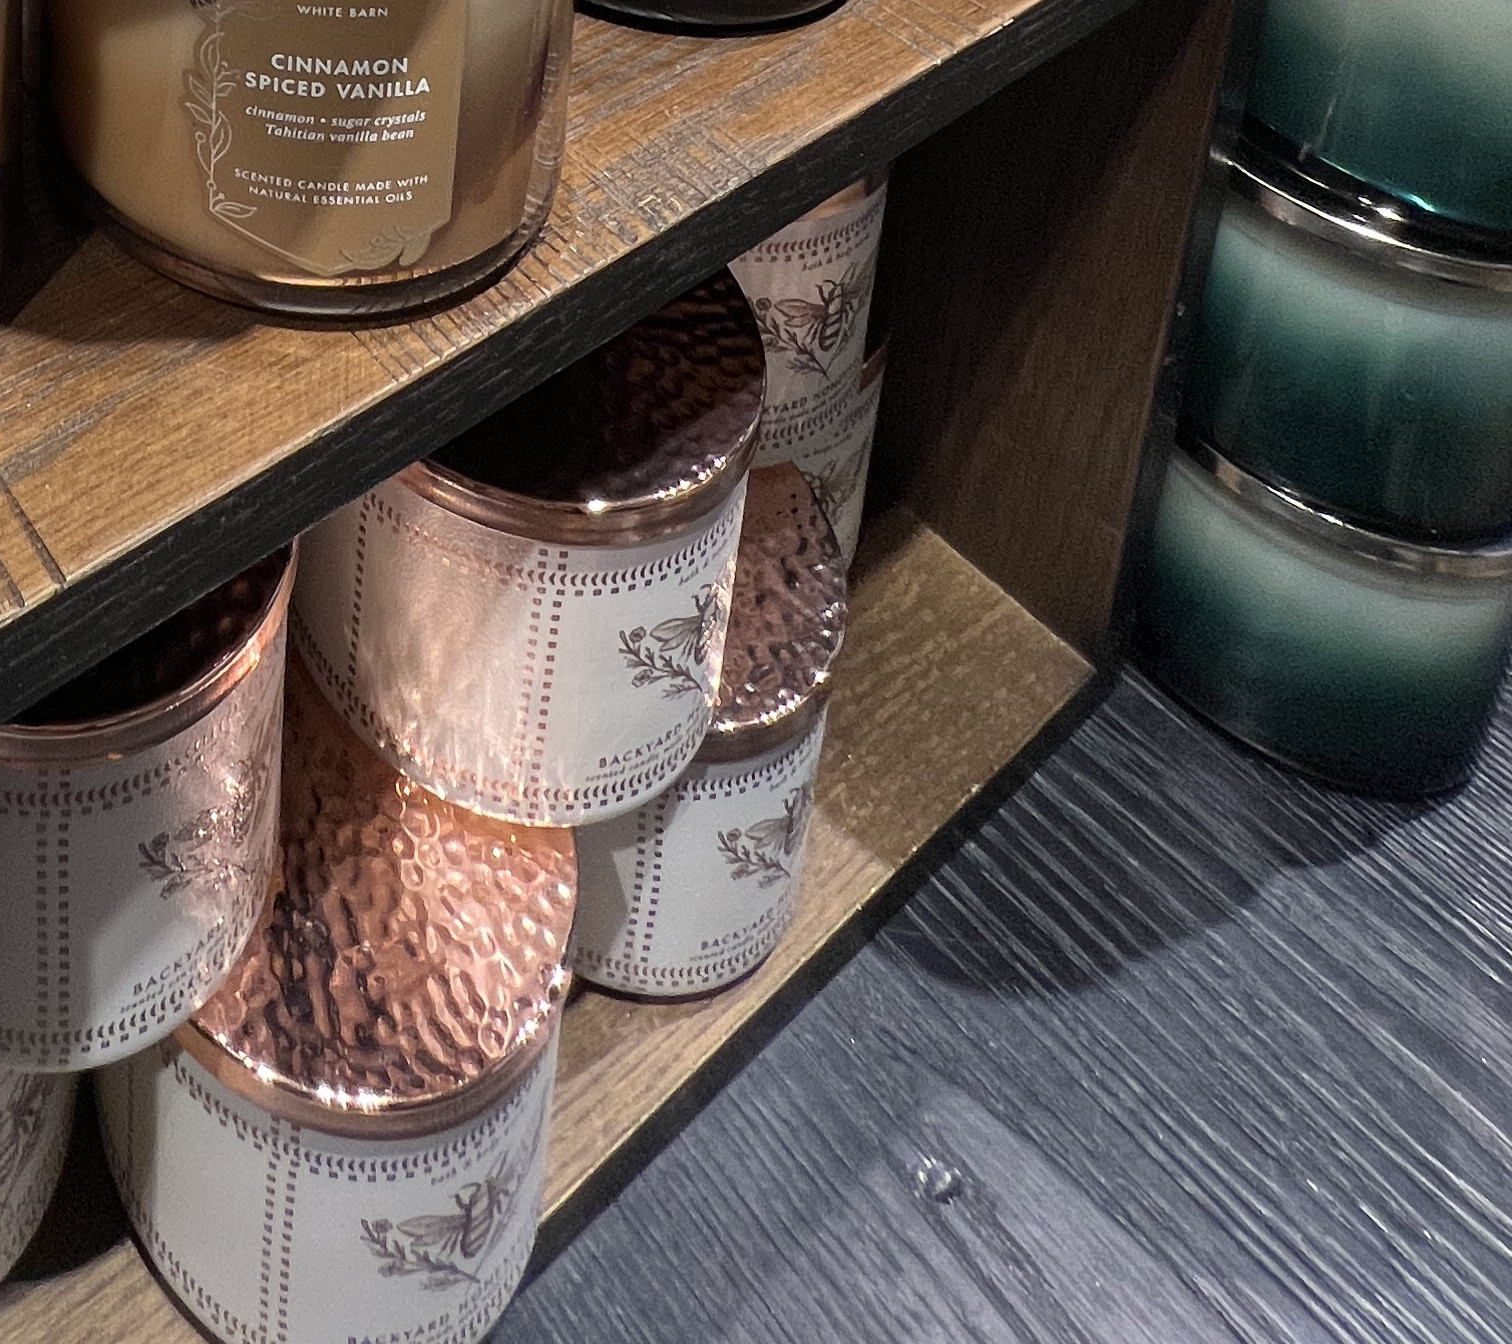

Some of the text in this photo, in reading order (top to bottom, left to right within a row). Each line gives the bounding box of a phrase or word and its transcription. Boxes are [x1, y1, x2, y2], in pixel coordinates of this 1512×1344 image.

[297, 5, 388, 18] WHITE BARN
[271, 54, 408, 75] CINNAMON
[245, 72, 430, 99] SPICED VANILLA
[246, 105, 425, 129] cinnamon sugar crystals
[265, 123, 414, 142] Tahitian vanilla bean
[235, 169, 428, 192] SCENTED CANDLE MADE WITH
[249, 187, 413, 205] NATURAL ESSENTIAL OILS
